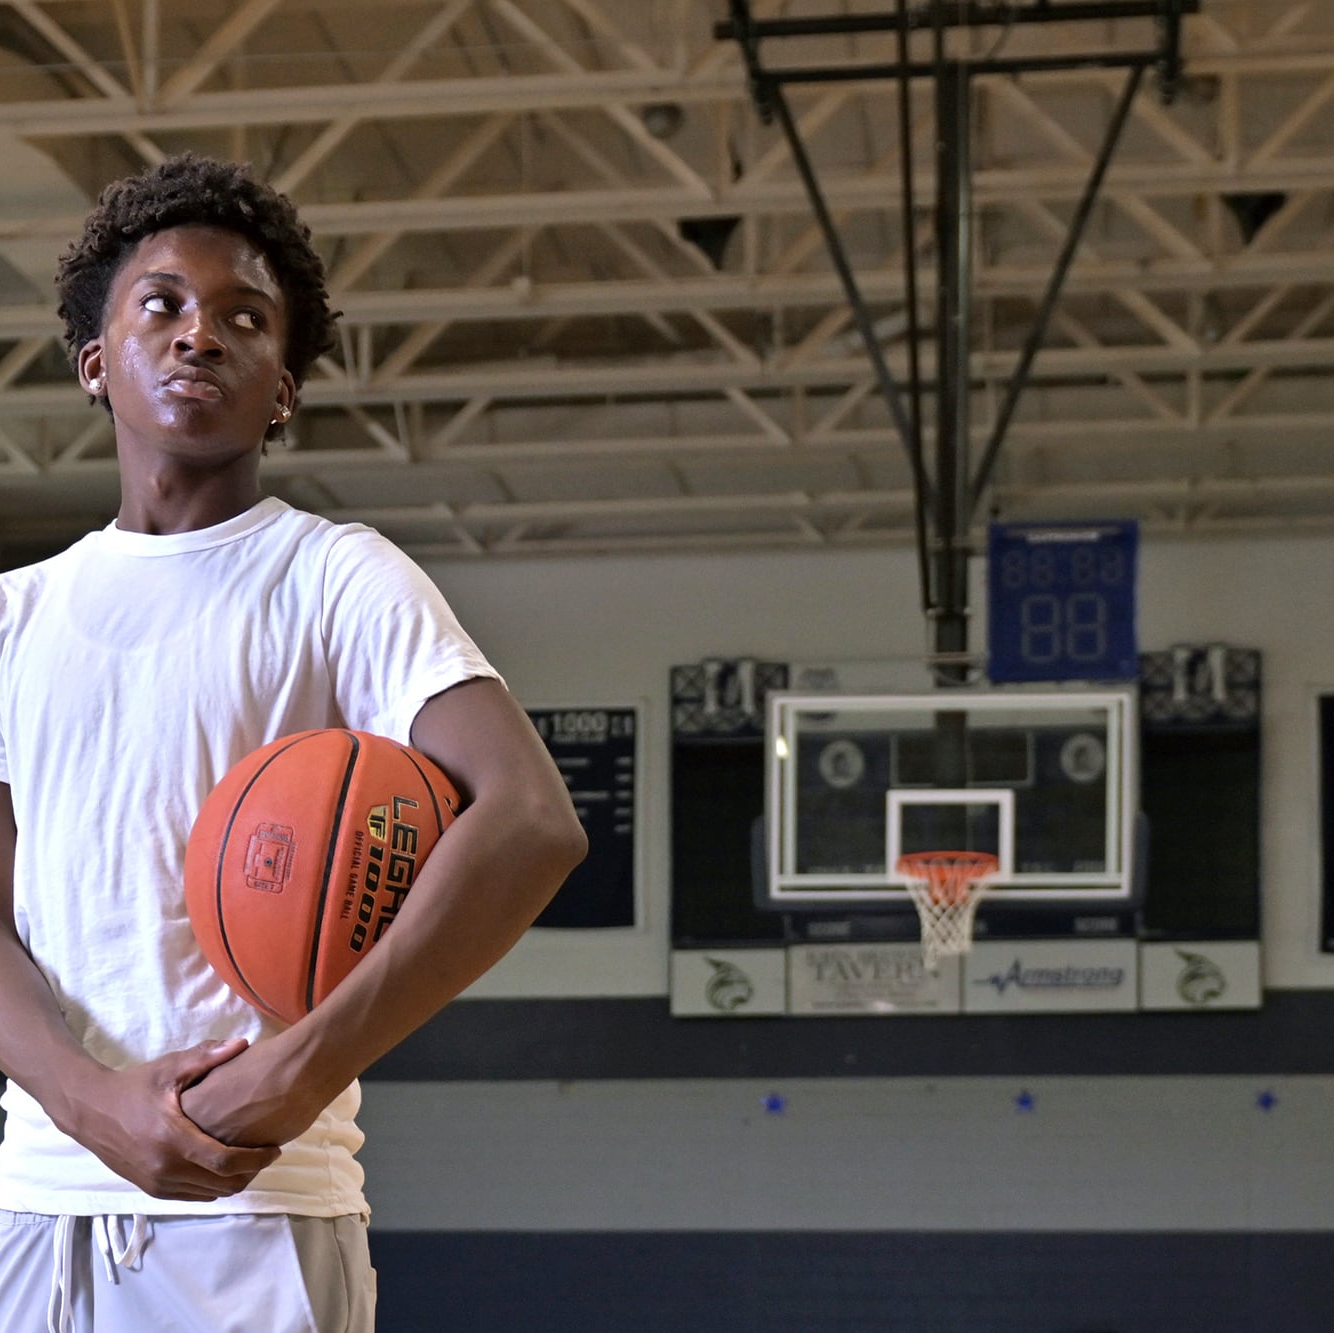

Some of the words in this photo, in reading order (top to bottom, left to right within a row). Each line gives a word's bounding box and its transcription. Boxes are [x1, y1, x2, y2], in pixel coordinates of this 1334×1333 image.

[350, 831, 365, 869] OFFICIAL
[345, 872, 359, 898] GAME
[372, 796, 419, 943] LEGAC
[340, 899, 354, 920] BALL
[349, 845, 384, 953] 1000
[813, 958, 940, 982] TAVER
[999, 957, 1125, 988] Armstrong
